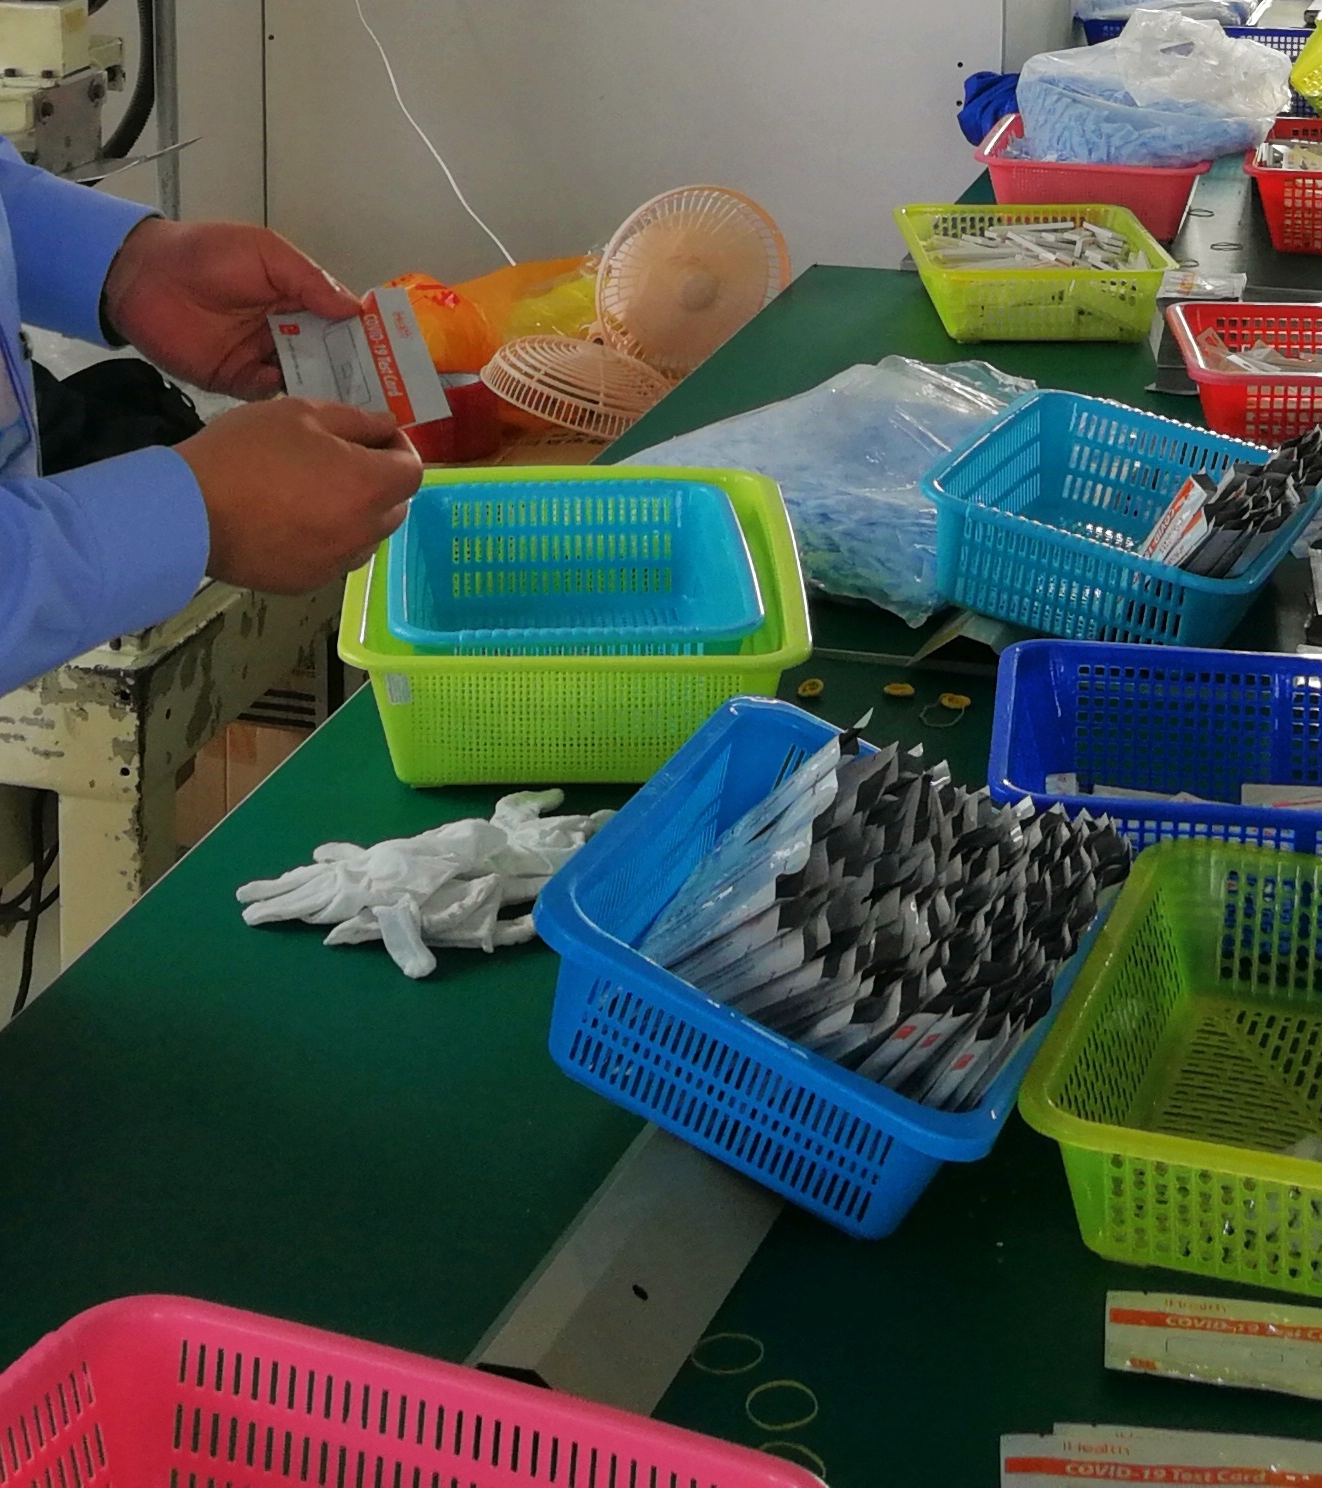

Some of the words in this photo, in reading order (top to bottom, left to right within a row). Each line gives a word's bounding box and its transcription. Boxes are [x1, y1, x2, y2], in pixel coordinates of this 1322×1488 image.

[363, 313, 388, 355] COVID-19
[377, 355, 393, 377] Test
[383, 376, 404, 398] Card
[1164, 1315, 1260, 1335] COVID-19
[1065, 1462, 1167, 1481] COVID-19
[1172, 1467, 1212, 1483] Test
[1217, 1469, 1267, 1485] Card
